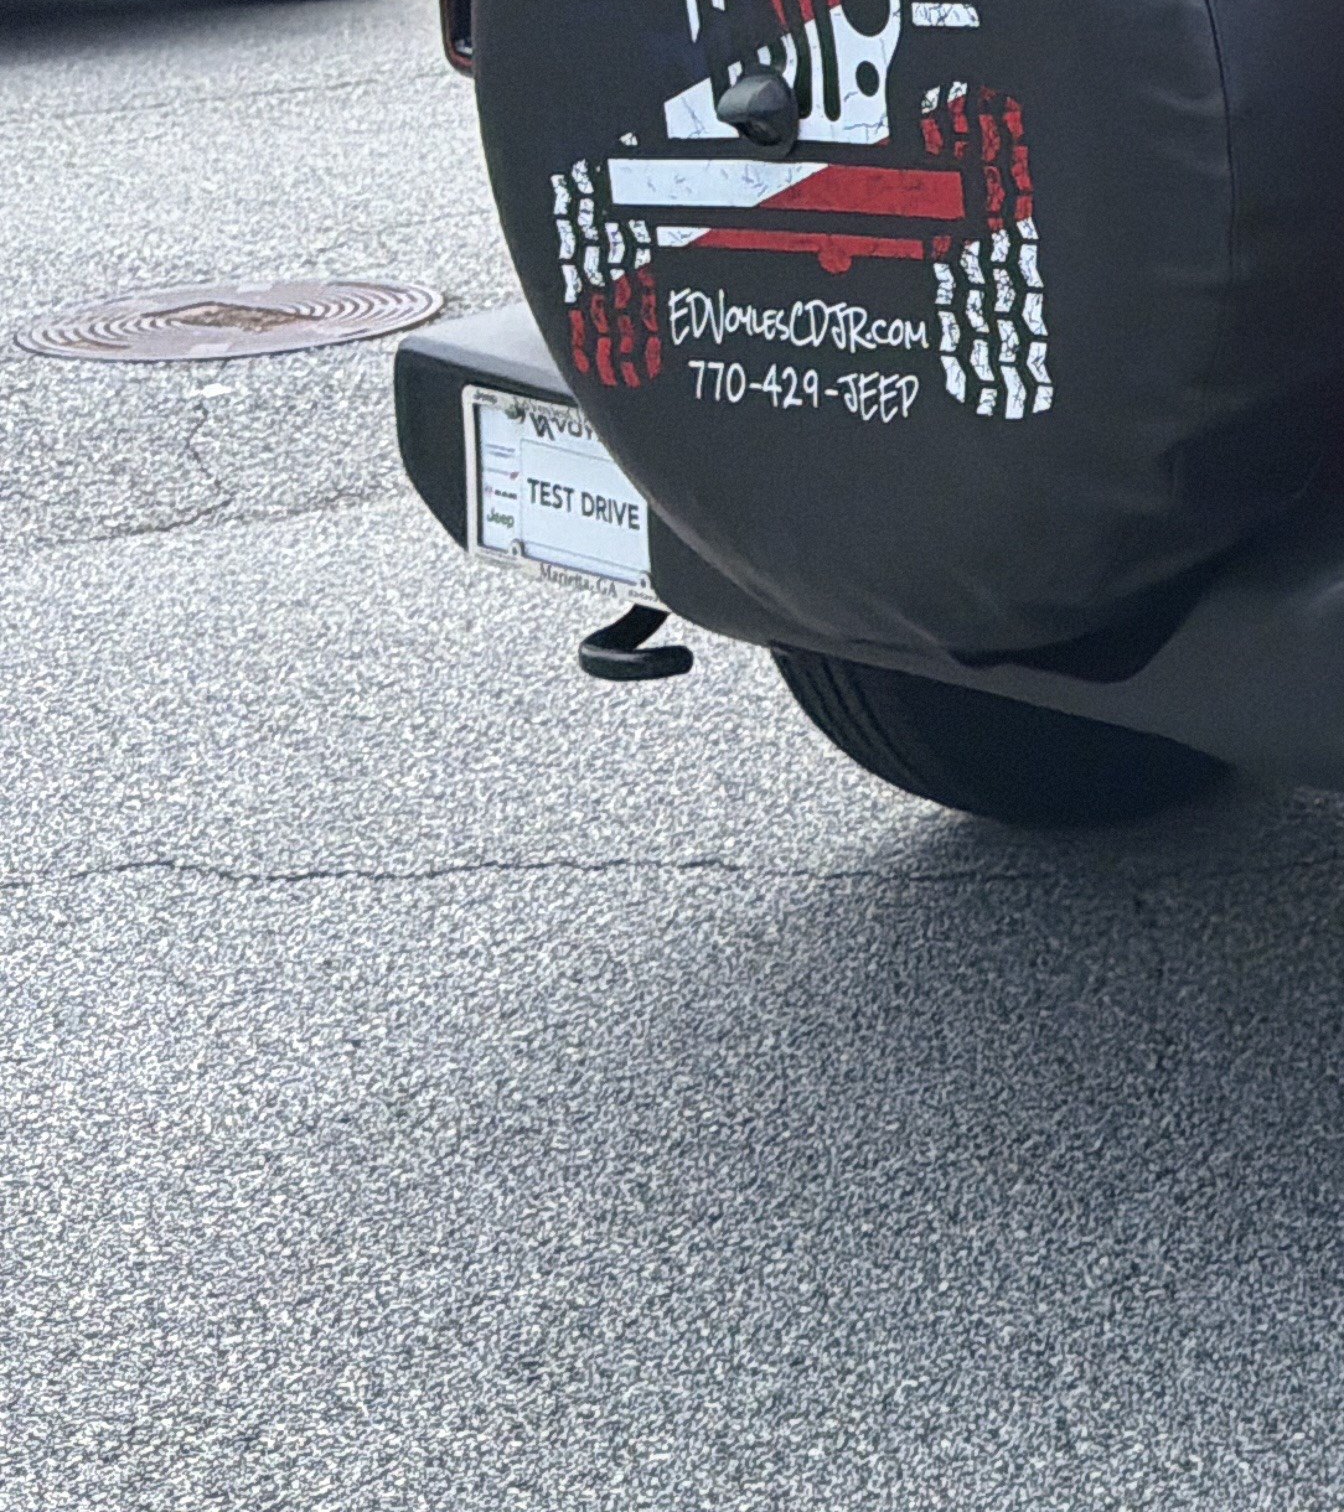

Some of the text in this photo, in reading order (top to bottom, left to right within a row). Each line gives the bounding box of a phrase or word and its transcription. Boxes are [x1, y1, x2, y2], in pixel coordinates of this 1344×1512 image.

[687, 358, 919, 424] 770-429-JEEP
[527, 477, 574, 513] TEST
[581, 491, 640, 530] DRIVE
